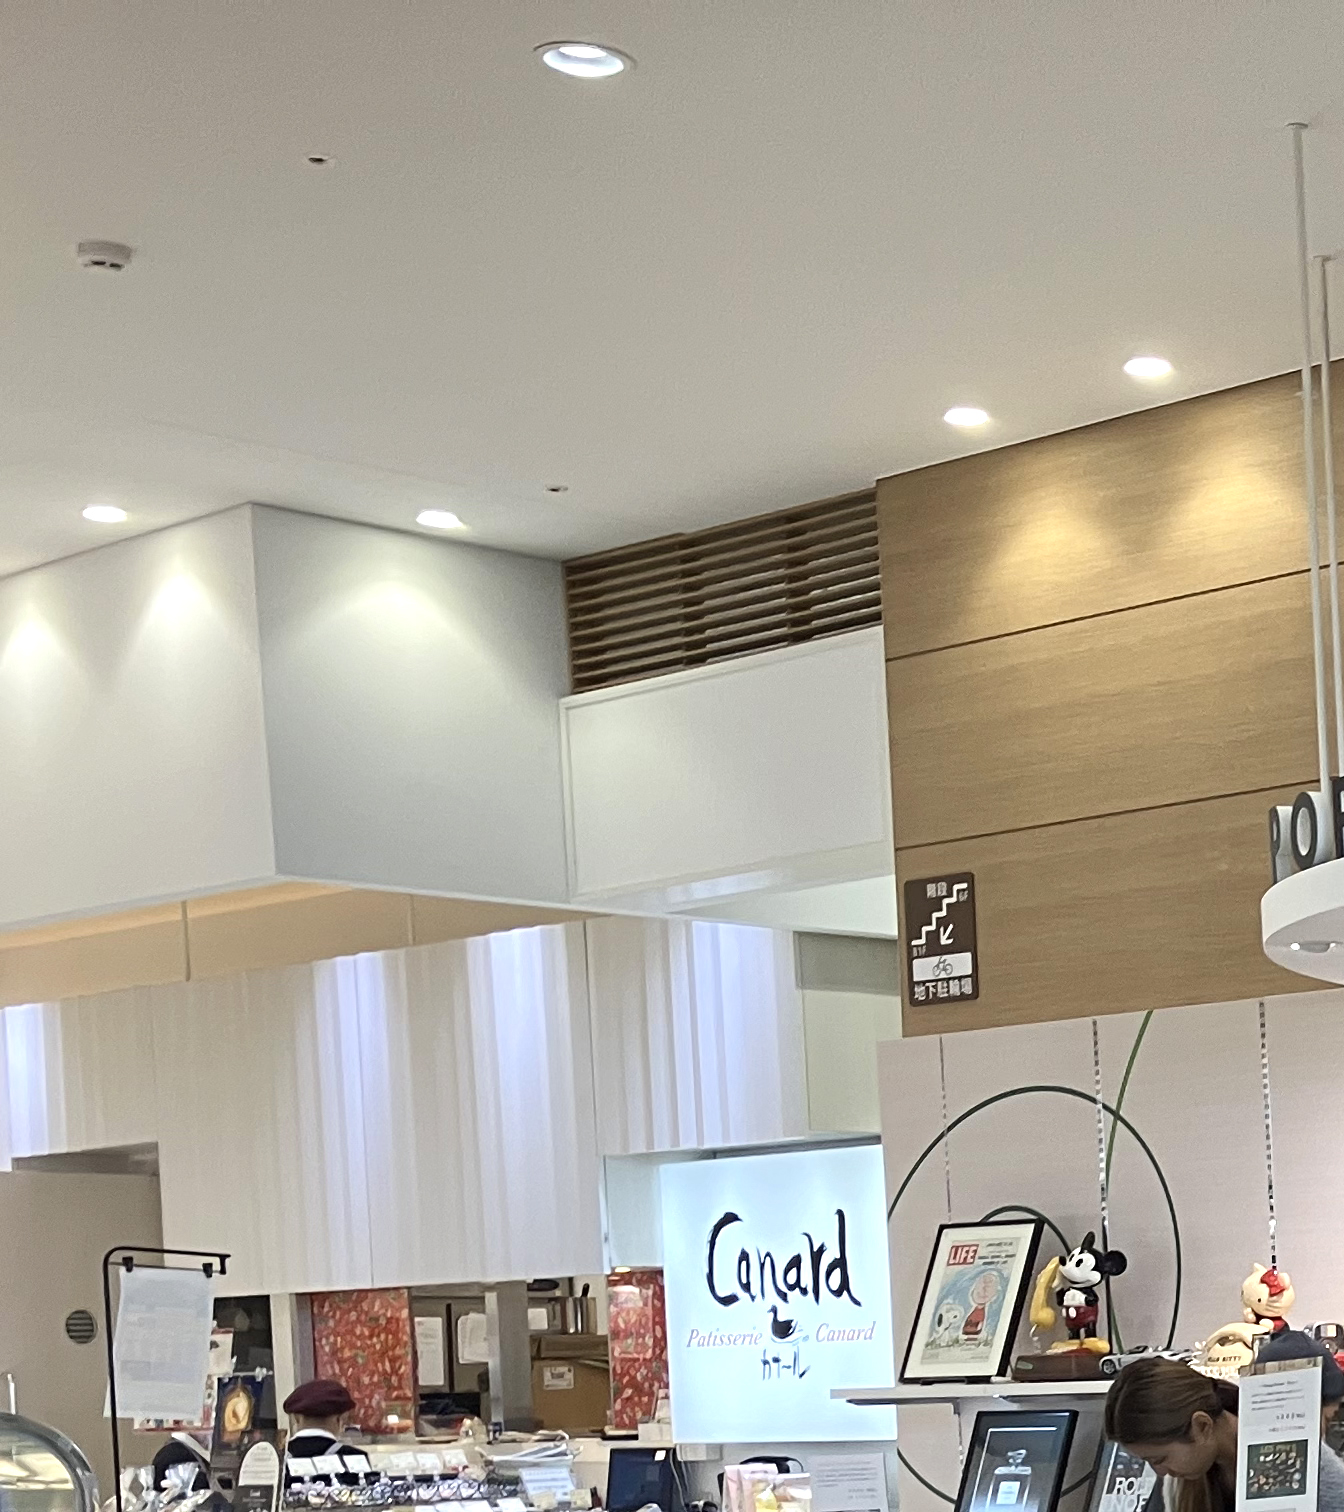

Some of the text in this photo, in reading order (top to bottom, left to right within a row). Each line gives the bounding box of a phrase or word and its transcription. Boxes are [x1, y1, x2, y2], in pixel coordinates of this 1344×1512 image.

[706, 1209, 863, 1307] Canard
[948, 1246, 978, 1265] LIFE
[686, 1321, 877, 1348] Patisserie Canard
